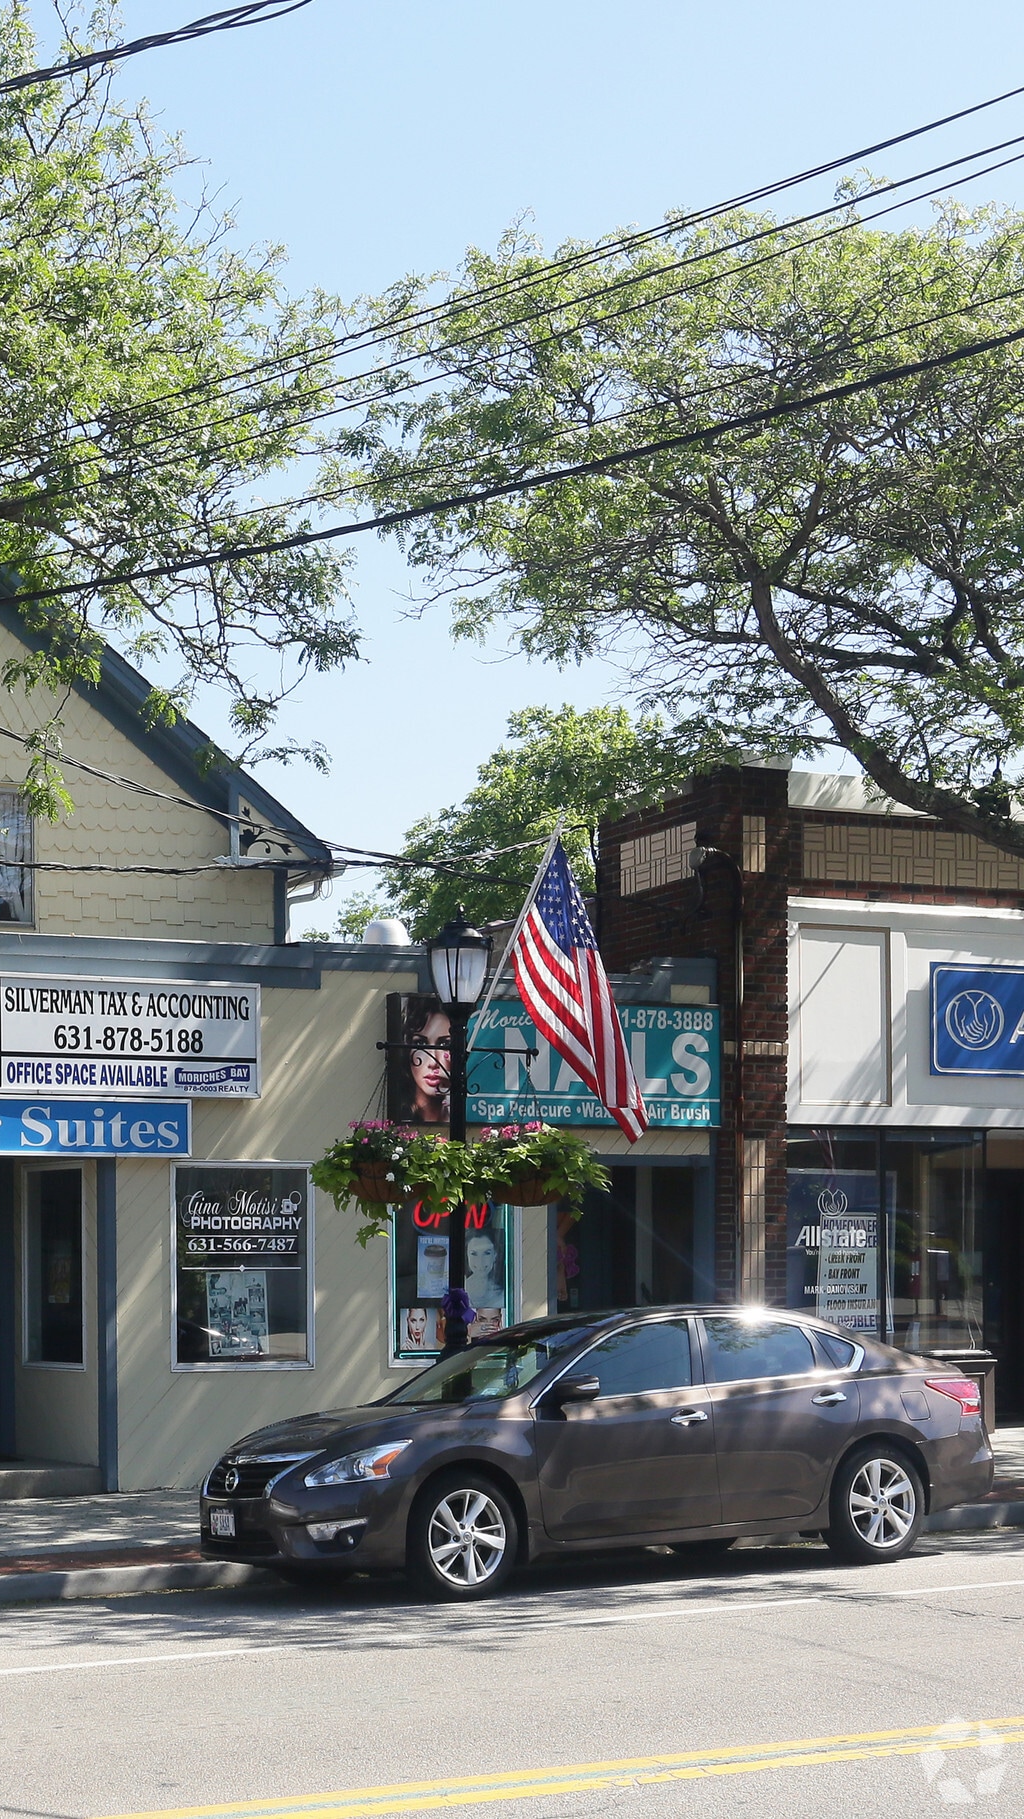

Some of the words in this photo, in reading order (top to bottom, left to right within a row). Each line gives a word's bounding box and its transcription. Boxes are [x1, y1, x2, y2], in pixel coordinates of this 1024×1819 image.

[4, 987, 94, 1015] SILVERMAN
[98, 991, 128, 1016] TAX
[132, 992, 143, 1017] &
[146, 993, 250, 1020] ACCOUNTING
[470, 1009, 534, 1029] Moric
[621, 1010, 713, 1031] 1-878-3888
[54, 1025, 203, 1054] 631-878-5188
[504, 1027, 711, 1096] NALS
[7, 1062, 52, 1084] OFFICE
[55, 1063, 97, 1085] SPACE
[100, 1065, 168, 1087] AVAILABLE
[178, 1070, 226, 1082] MORICHES
[230, 1068, 248, 1078] BAY
[510, 1100, 572, 1118] Pedicure
[581, 1102, 614, 1119] Wax
[647, 1104, 666, 1119] Air
[670, 1104, 711, 1120] Brush
[20, 1106, 180, 1149] Suites
[181, 1191, 223, 1223] Gina
[228, 1190, 277, 1216] Motisi
[413, 1196, 487, 1229] OPN
[191, 1216, 302, 1230] PHOTOGRAPHY
[187, 1238, 296, 1251] 631-566-7487
[795, 1225, 866, 1247] Allstate
[828, 1269, 839, 1279] BAY
[840, 1268, 860, 1279] FRONT
[827, 1299, 847, 1310] FLOOD
[847, 1299, 876, 1310] INSURAN
